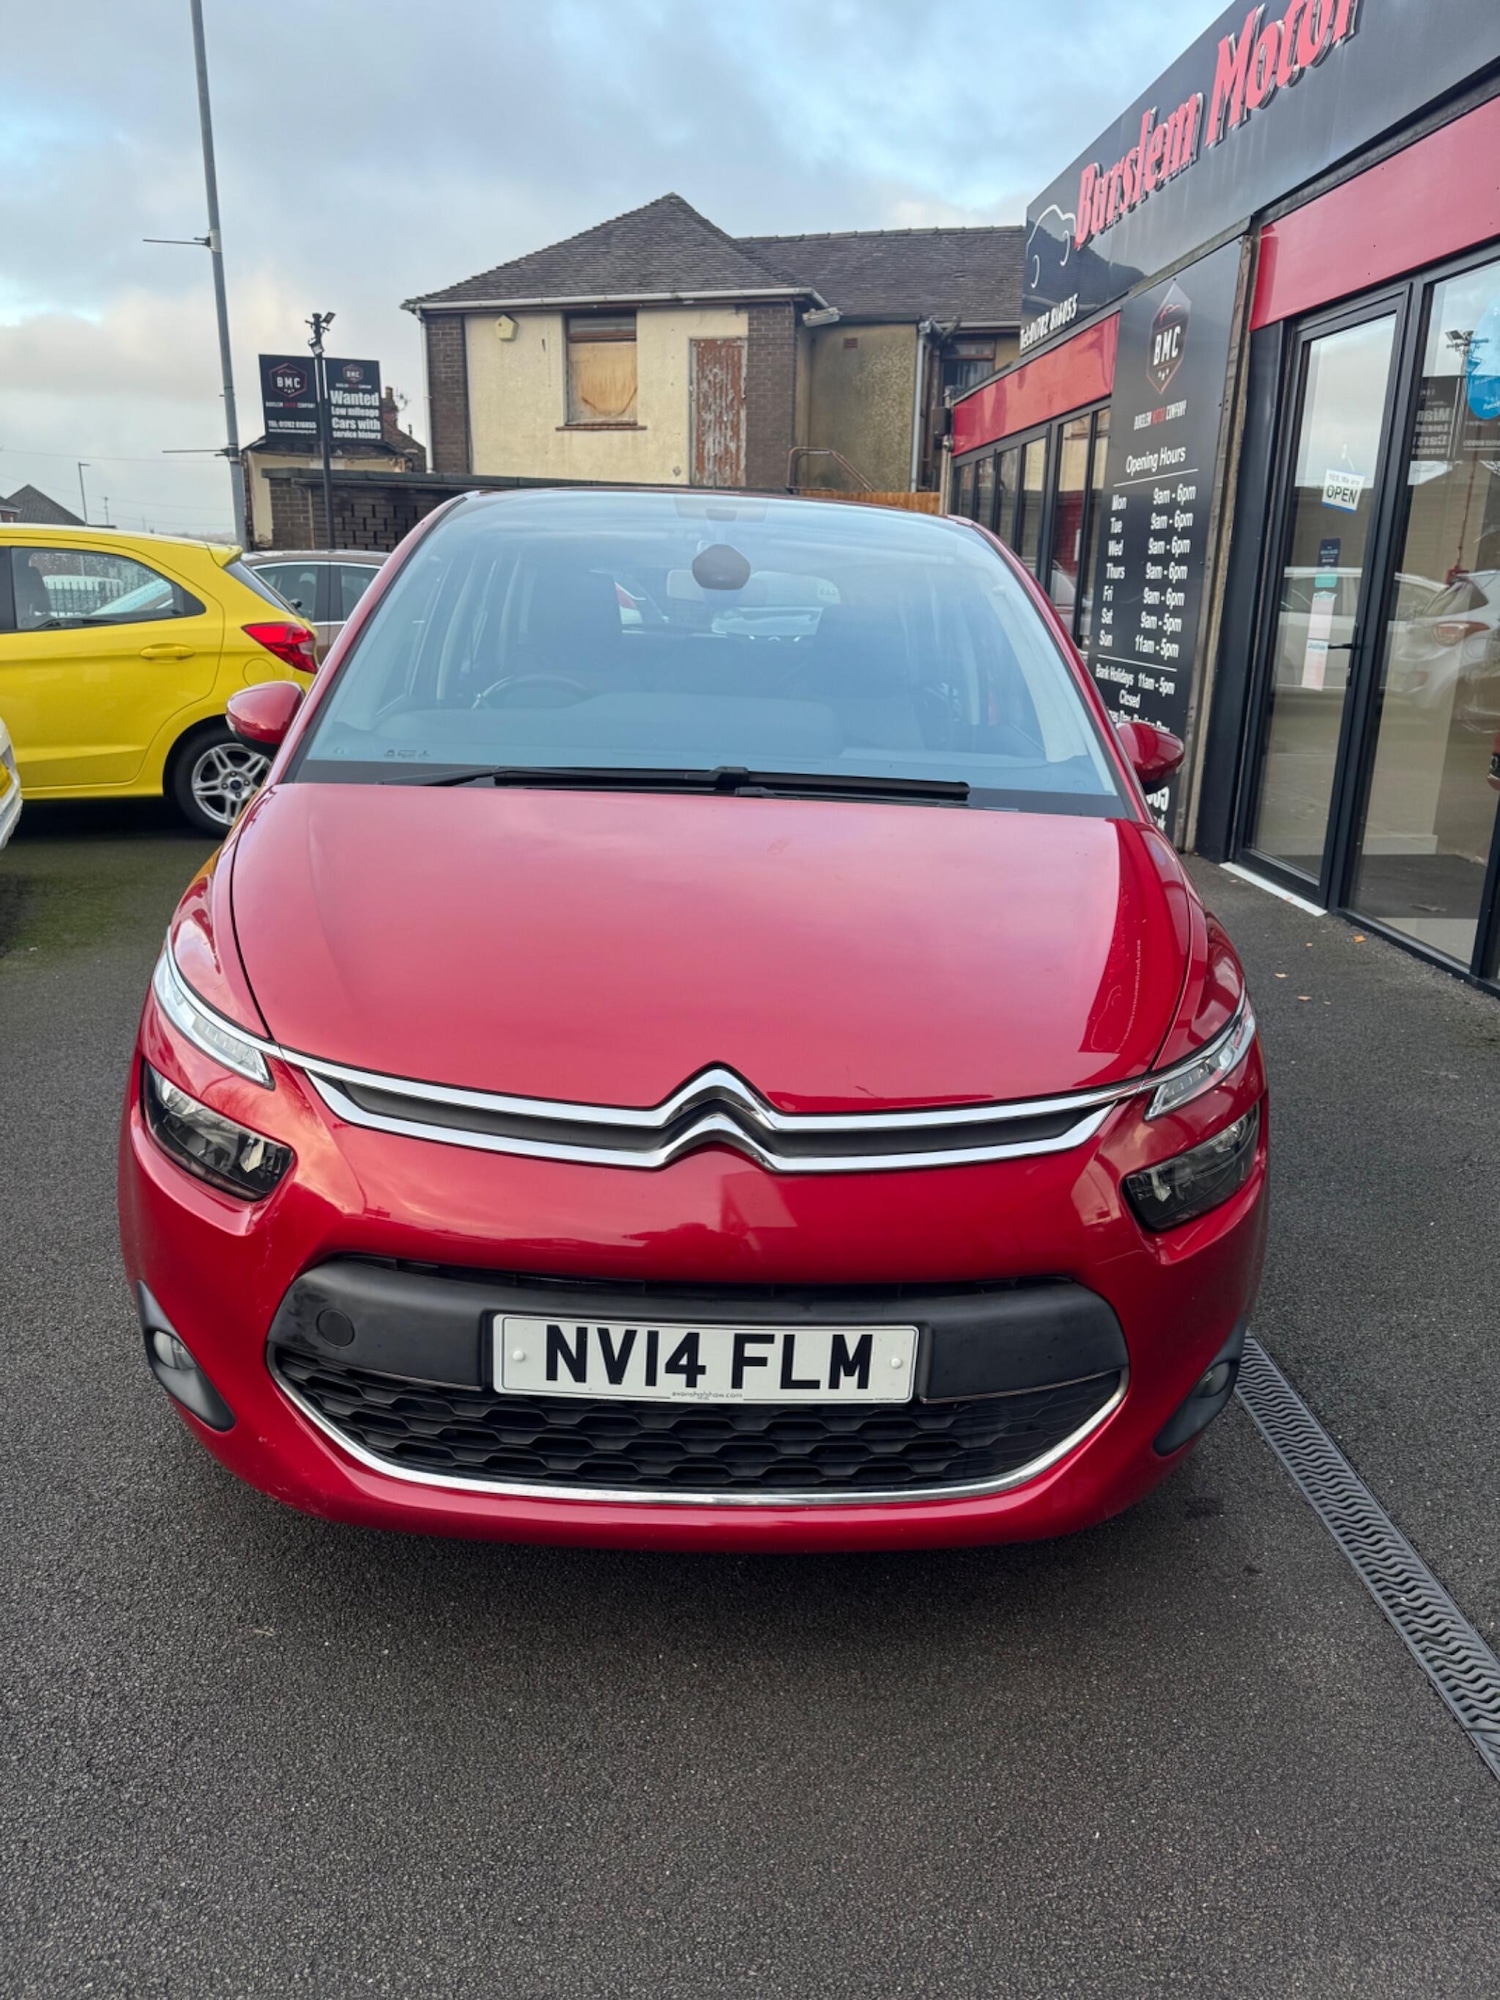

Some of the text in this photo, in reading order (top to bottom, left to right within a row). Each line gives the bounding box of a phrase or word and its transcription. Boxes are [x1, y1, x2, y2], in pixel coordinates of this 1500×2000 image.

[1075, 92, 1203, 250] Burslem
[1153, 325, 1181, 366] BMC
[276, 376, 301, 389] BMC
[346, 370, 360, 378] BMC
[330, 390, 379, 406] Wanted
[331, 406, 379, 418] Low mileage
[331, 417, 381, 430] Cars with
[332, 430, 382, 440] service history
[1126, 446, 1186, 476] Opening Hours
[1111, 494, 1127, 511] Mon
[1153, 487, 1170, 505] 9am
[1177, 483, 1196, 506] 6pm
[1326, 484, 1358, 505] OPEN
[1110, 517, 1123, 533] Tue
[1150, 512, 1168, 530] 9am
[1174, 509, 1193, 532] 6pm
[1108, 539, 1124, 556] Wed
[1148, 537, 1165, 554] 9am
[1171, 535, 1190, 558] 6pm
[1106, 562, 1125, 579] Thurs
[1145, 562, 1163, 579] 9am
[1168, 561, 1188, 584] 6pm
[1103, 585, 1113, 601] Fri
[1143, 586, 1160, 604] 9am
[1166, 587, 1185, 610] 6pm
[1101, 607, 1113, 624] Sat
[1140, 610, 1157, 629] 9am
[1163, 613, 1182, 635] 5pm
[1099, 629, 1113, 647] Sun
[1135, 634, 1155, 654] 11am
[1160, 637, 1179, 661] 5pm
[1096, 663, 1109, 679] Bank
[1110, 666, 1134, 688] Holidays
[1138, 672, 1155, 690] 11am
[1159, 676, 1175, 697] 5pm
[1118, 689, 1141, 709] Closed
[545, 1324, 873, 1390] NV14 FLM
